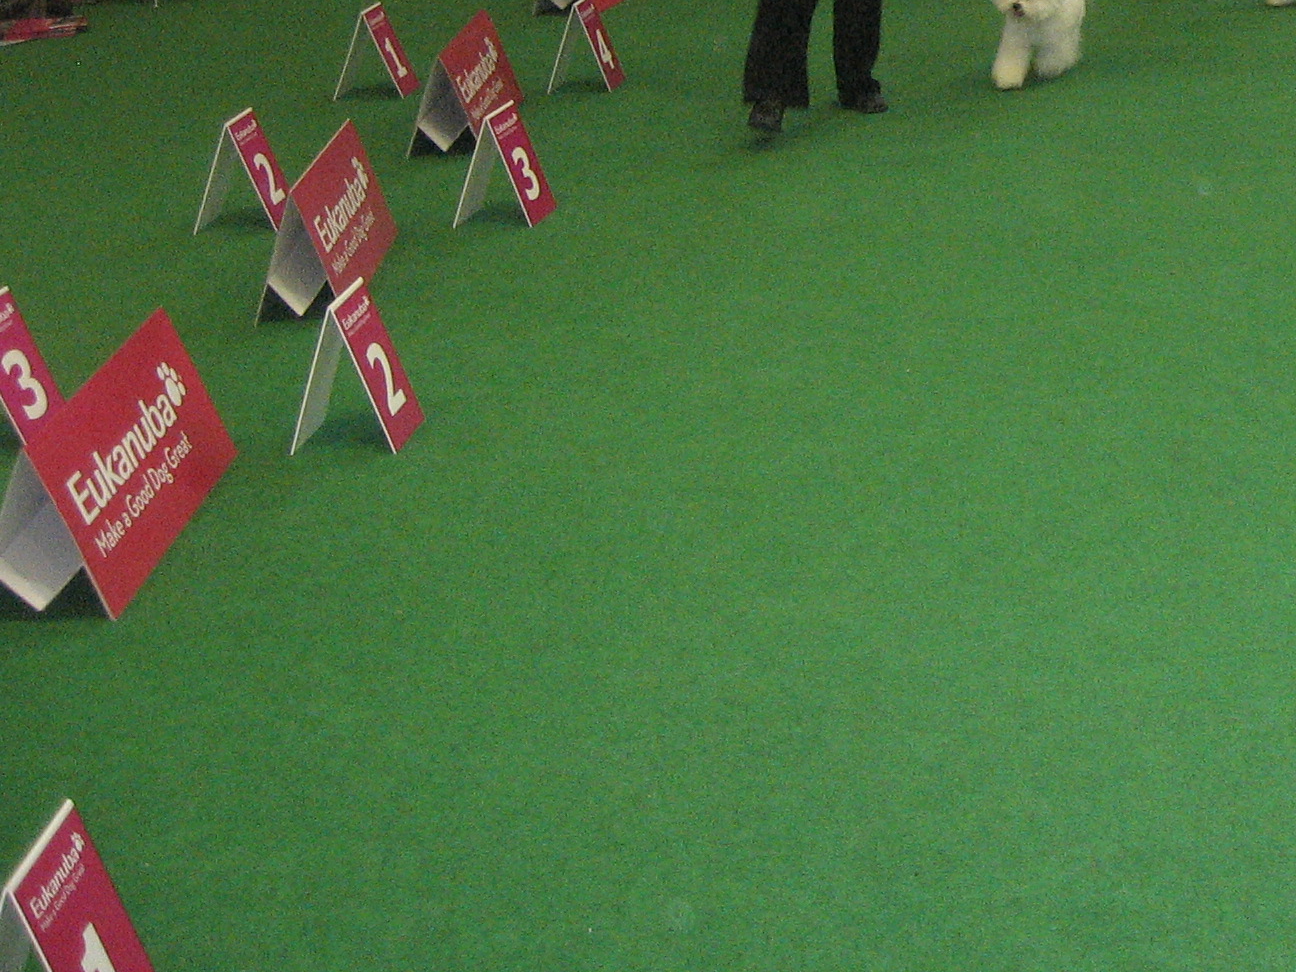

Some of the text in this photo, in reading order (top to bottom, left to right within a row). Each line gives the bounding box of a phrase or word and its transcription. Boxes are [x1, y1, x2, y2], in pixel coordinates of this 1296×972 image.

[385, 36, 408, 79] 1
[455, 50, 497, 104] Eukanuba
[596, 29, 615, 70] 4
[253, 152, 287, 206] 2
[511, 146, 540, 201] 3
[313, 178, 367, 254] Eukanuba
[1, 349, 48, 420] 3
[366, 342, 407, 417] 2
[66, 394, 178, 526] Eukanuba
[94, 430, 193, 558] Make a Good Dog Great
[30, 847, 80, 919] Eukanuba
